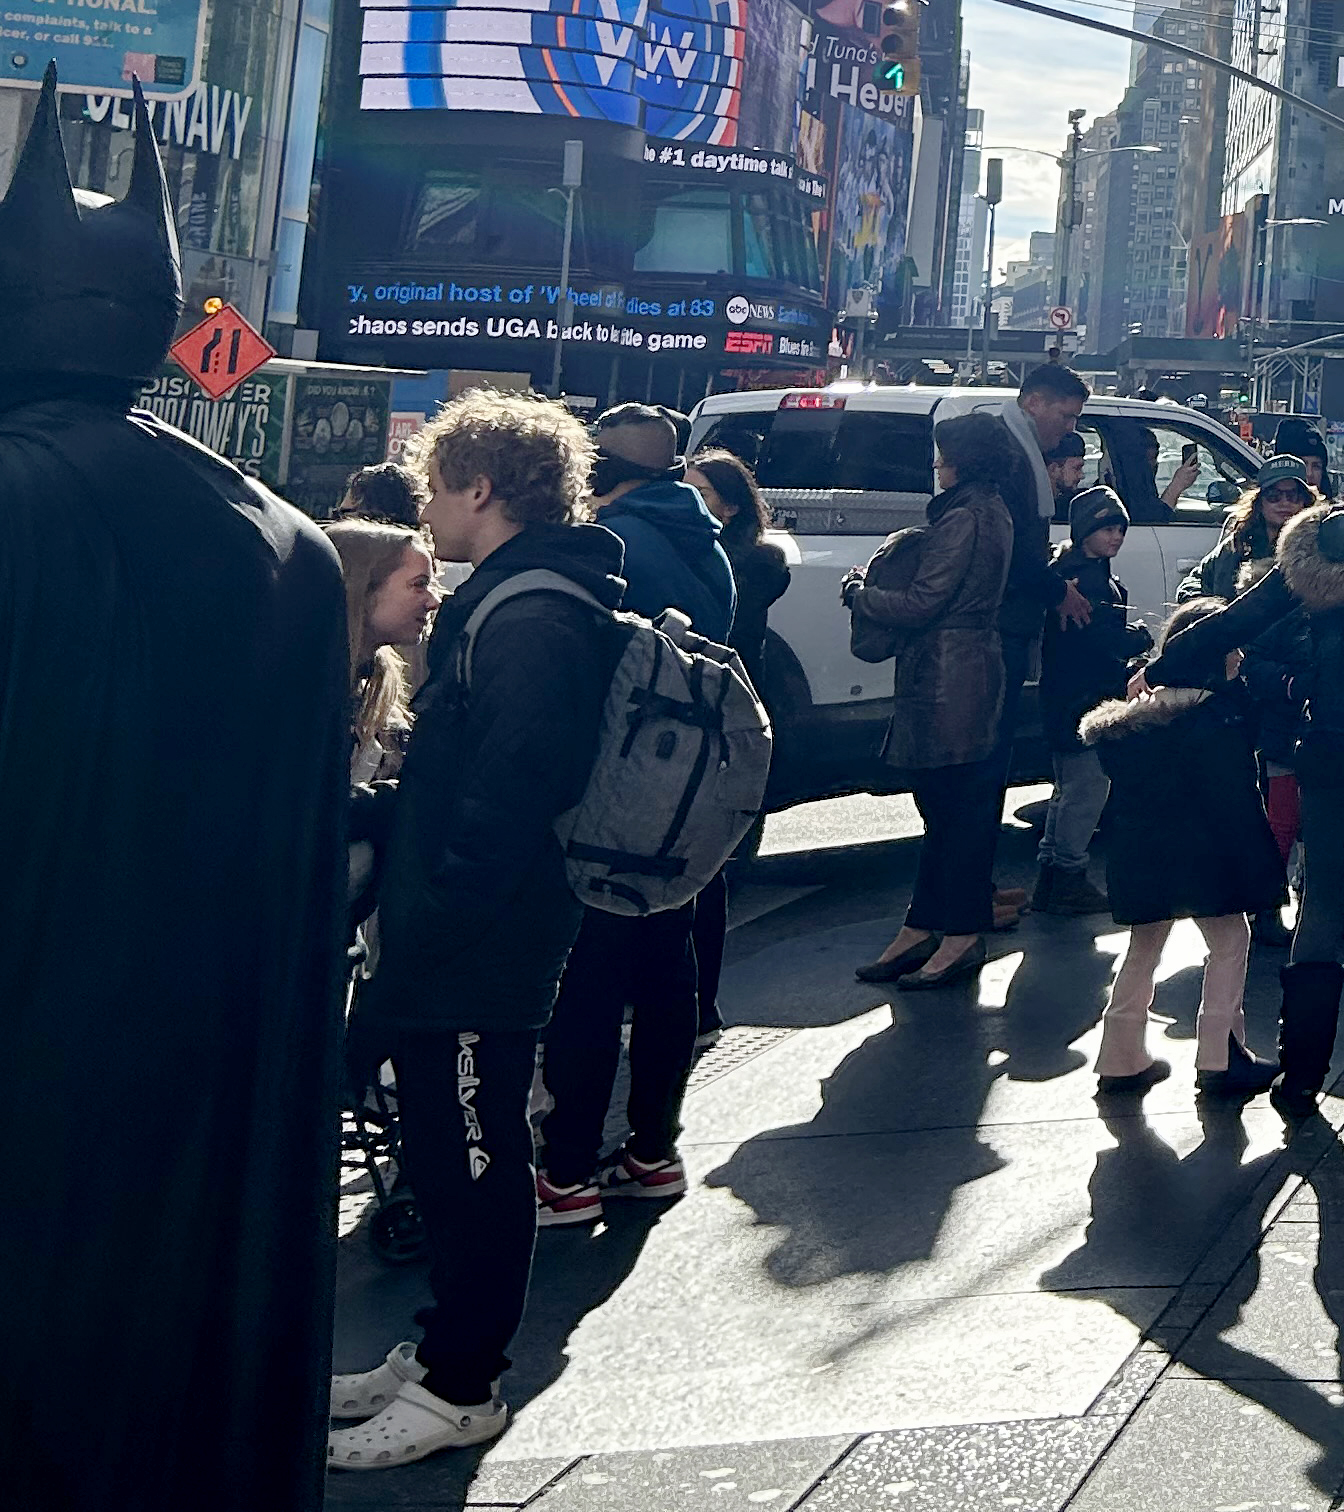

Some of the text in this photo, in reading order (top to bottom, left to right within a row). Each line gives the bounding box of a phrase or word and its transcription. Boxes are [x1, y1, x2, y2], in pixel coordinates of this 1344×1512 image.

[4, 12, 90, 31] complaints,
[94, 20, 121, 33] talk
[125, 23, 140, 34] to
[34, 32, 49, 42] or
[52, 32, 80, 44] call
[826, 35, 878, 65] Tuna's
[162, 80, 253, 161] NAVY
[659, 146, 686, 167] #1
[690, 150, 768, 174] daytime
[374, 281, 443, 305] original
[448, 282, 502, 303] host
[508, 284, 534, 304] of
[626, 296, 662, 316] dies
[667, 299, 686, 317] at
[689, 298, 715, 317] 83
[728, 304, 747, 315] abc
[749, 303, 775, 320] NEWS
[411, 316, 480, 338] sends
[486, 318, 541, 339] UGA
[596, 323, 609, 342] to
[647, 333, 708, 352] game
[724, 331, 774, 355] ESPN
